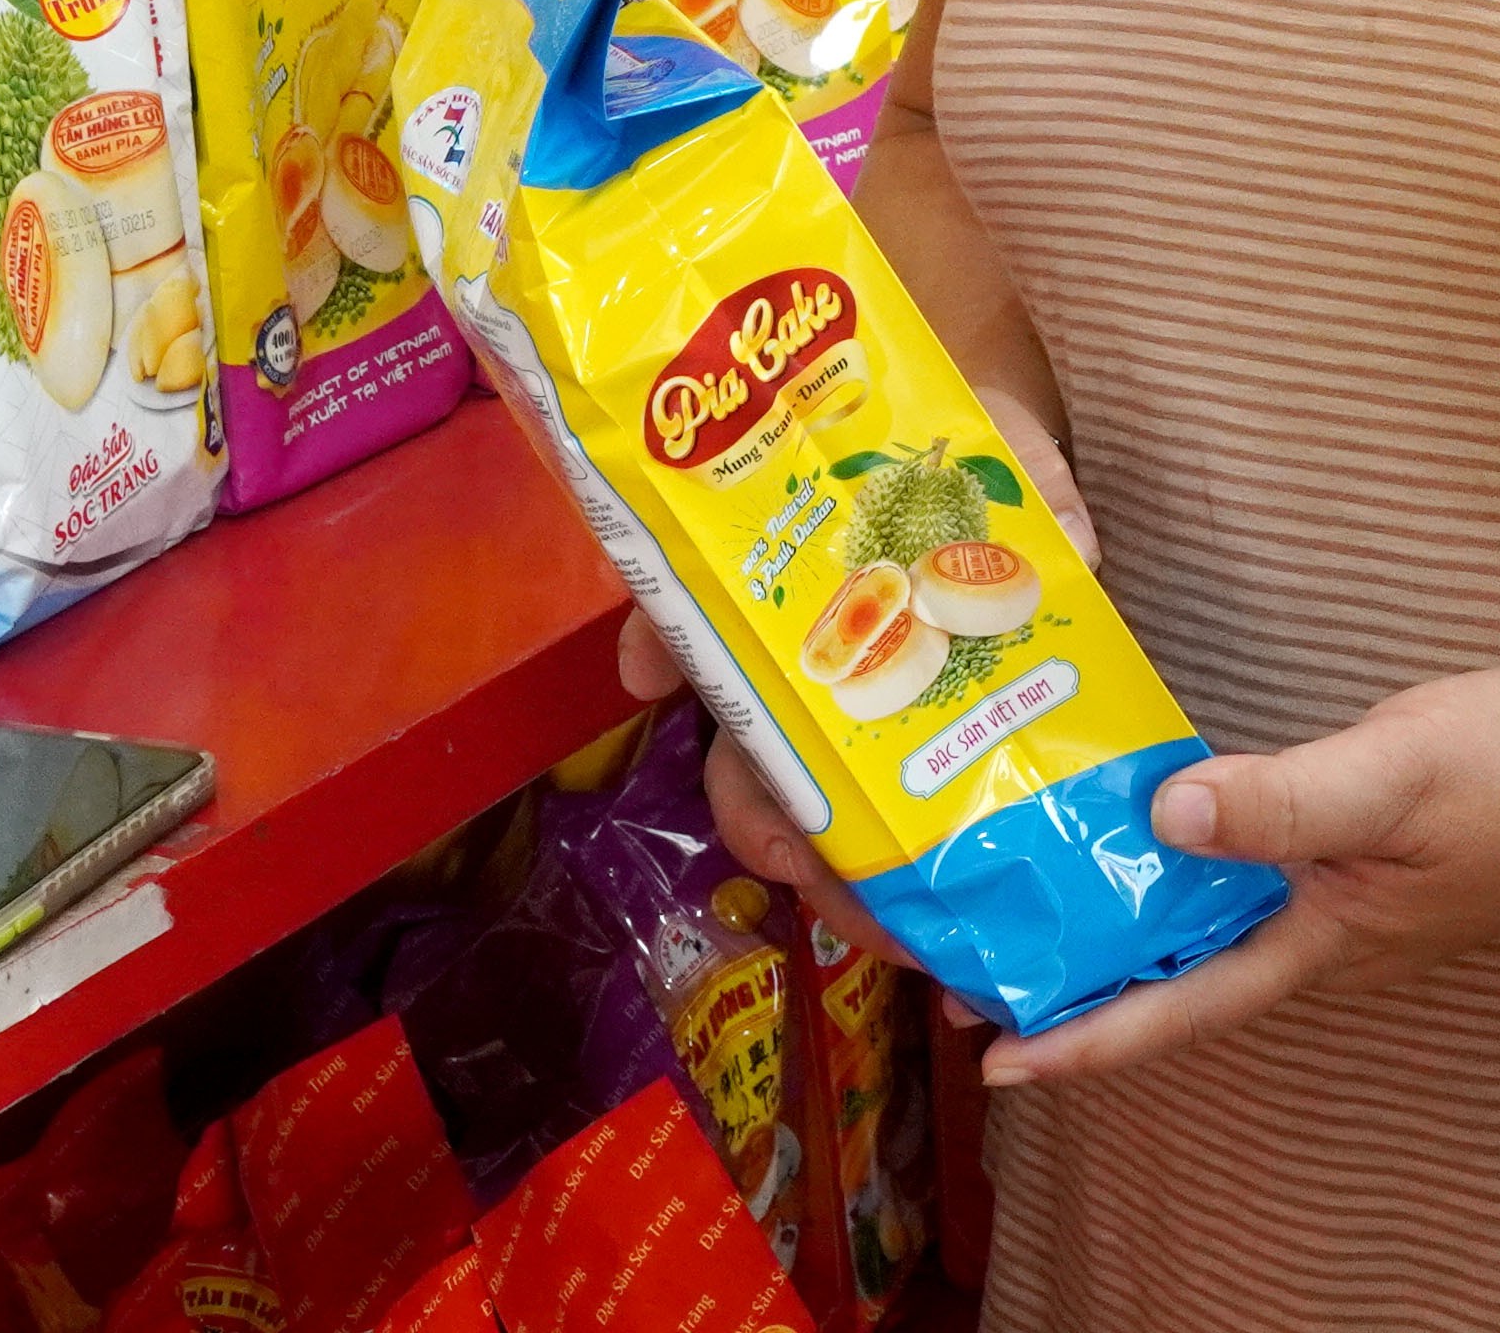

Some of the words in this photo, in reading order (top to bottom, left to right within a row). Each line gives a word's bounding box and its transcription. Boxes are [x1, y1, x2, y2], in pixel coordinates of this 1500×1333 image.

[373, 324, 442, 365] VIETNAM
[652, 366, 749, 460] Pia
[730, 280, 842, 382] Cake
[712, 445, 762, 484] Mung
[758, 411, 795, 450] Bean
[796, 354, 850, 404] Durian
[54, 504, 97, 550] SÓC
[97, 449, 160, 514] TRĂNG
[739, 537, 768, 575] 100%
[765, 478, 815, 536] Natural
[751, 576, 767, 601] &
[762, 543, 796, 592] Fresh
[793, 495, 838, 552] Durian
[927, 742, 959, 776] ĐẶC
[957, 720, 988, 752] SẢN
[985, 699, 1018, 729] VIỆT
[1017, 678, 1054, 710] NAM
